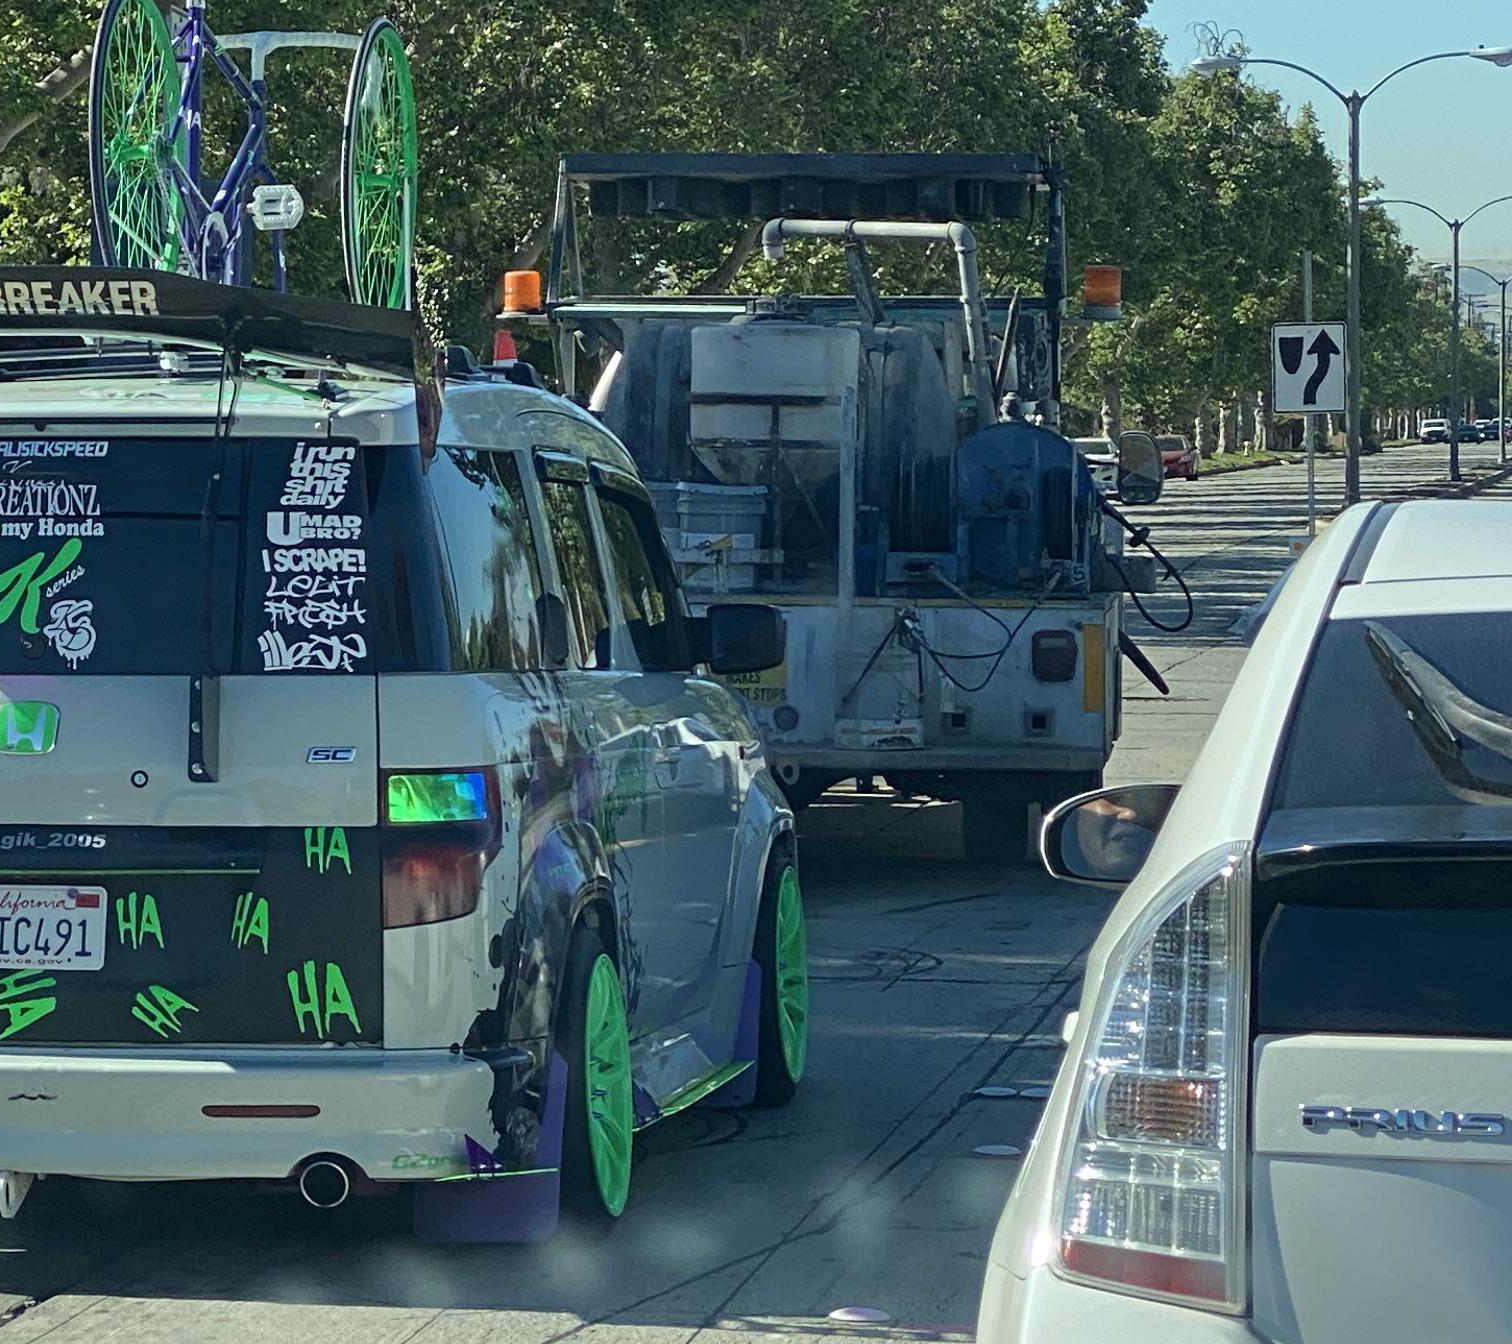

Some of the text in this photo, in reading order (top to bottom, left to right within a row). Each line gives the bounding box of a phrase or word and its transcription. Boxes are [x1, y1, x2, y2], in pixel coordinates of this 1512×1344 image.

[1, 522, 34, 540] my
[38, 518, 105, 537] Honda
[267, 511, 306, 546] U
[300, 514, 363, 528] MAD
[300, 527, 362, 540] BRO?
[262, 547, 367, 573] I SCRAPE!
[46, 565, 86, 598] series
[311, 749, 352, 761] SC
[304, 825, 352, 875] HA
[115, 891, 165, 950] HA
[230, 891, 270, 955] HA
[131, 985, 200, 1039] HA
[287, 960, 363, 1040] HA
[1299, 1104, 1506, 1136] PRIUS
